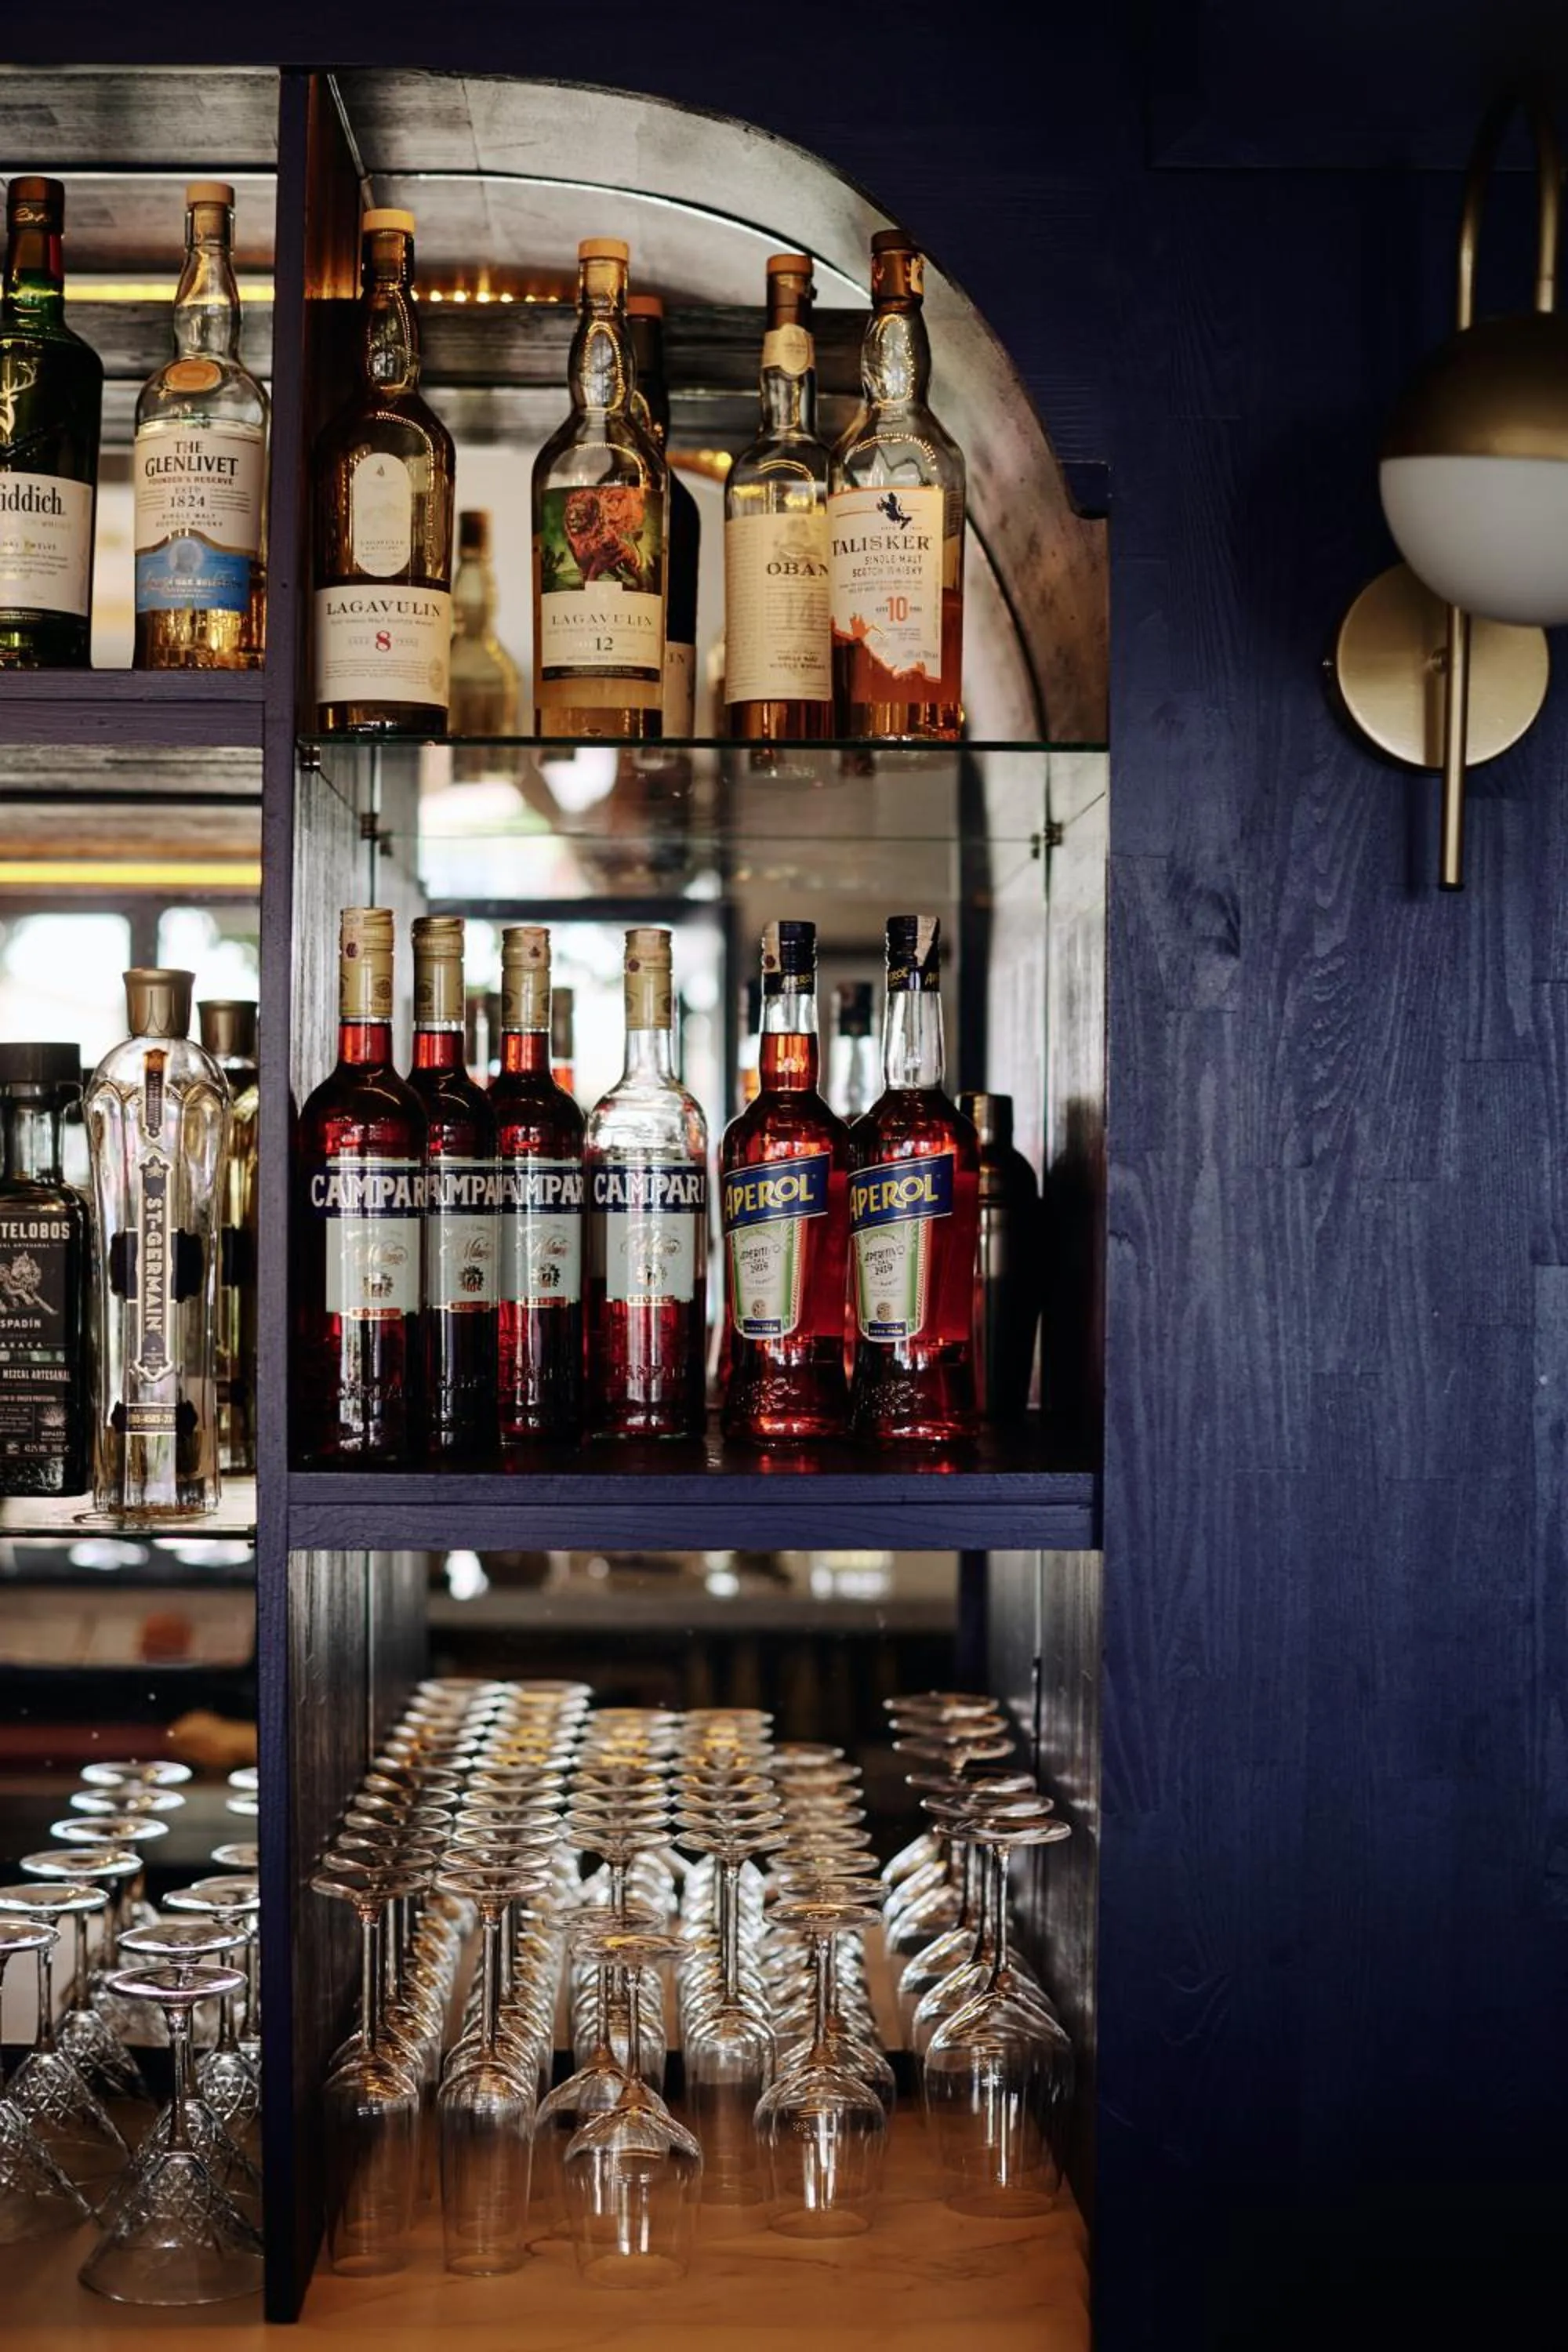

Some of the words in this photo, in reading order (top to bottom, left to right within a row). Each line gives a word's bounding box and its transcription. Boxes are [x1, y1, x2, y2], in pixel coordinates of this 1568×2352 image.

[175, 441, 203, 454] THE
[145, 456, 239, 477] GLENLIVET
[194, 476, 234, 486] RESERVE
[170, 495, 205, 508] 1824
[832, 535, 931, 557] TALISKER
[766, 562, 829, 576] OBAN
[326, 599, 441, 617] LAGAVULIN
[887, 596, 908, 622] 10
[551, 613, 653, 626] LAGAVULIN
[375, 630, 391, 652] 8
[595, 636, 614, 652] 12
[593, 1173, 705, 1205] CAMPARI
[725, 1174, 815, 1221] APEROL
[850, 1174, 939, 1221] APEROL
[0, 1221, 71, 1240] TELOBOS
[739, 1243, 782, 1260] APERITIO
[146, 1197, 164, 1332] ST-GERMAIN
